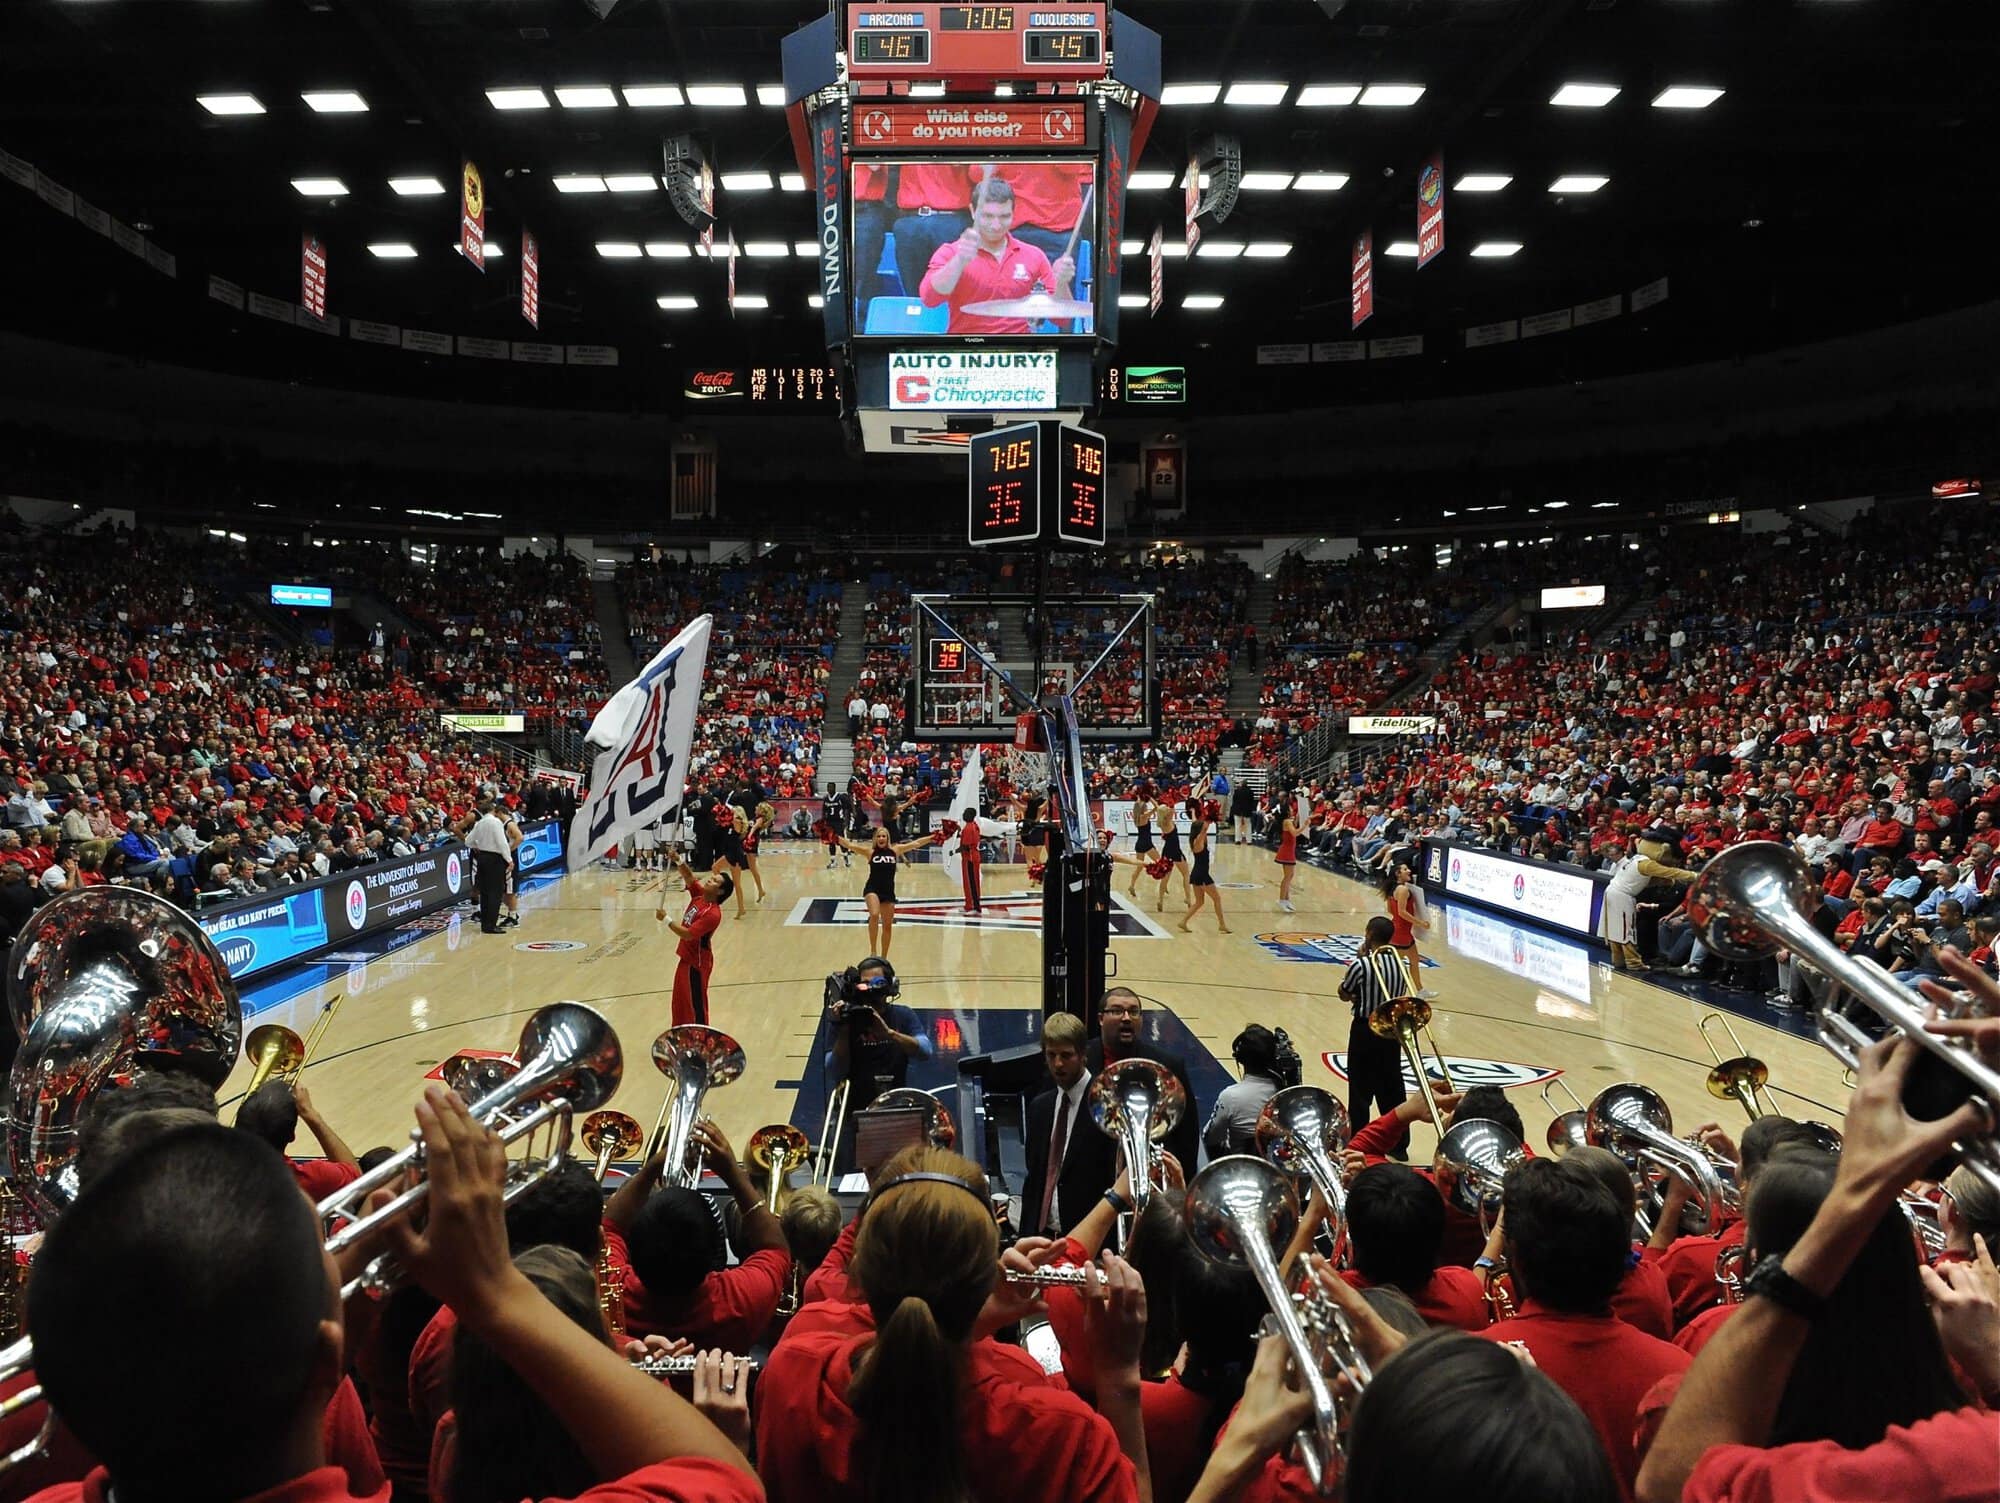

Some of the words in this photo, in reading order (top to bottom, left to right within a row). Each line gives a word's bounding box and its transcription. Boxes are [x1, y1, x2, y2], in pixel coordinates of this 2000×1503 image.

[869, 14, 914, 26] ARIZONA
[960, 8, 1013, 29] 7:05
[1034, 13, 1090, 26] DUQUESNE
[880, 36, 911, 57] 46
[1052, 36, 1082, 57] 45
[926, 109, 969, 123] What
[976, 110, 1008, 123] else
[912, 123, 934, 138] do
[938, 125, 967, 140] you
[971, 123, 1023, 138] need?
[1422, 231, 1439, 257] 2001
[893, 354, 953, 368] AUTO
[959, 354, 1054, 368] INJURY?
[693, 371, 735, 386] Coca-Cola
[934, 387, 1046, 404] Chiropractic
[990, 440, 1032, 472] 7:05
[1073, 443, 1101, 475] 7:05
[985, 481, 1021, 526] 35
[1070, 481, 1096, 526] 35
[941, 643, 962, 652] 7:05
[938, 654, 958, 667] 35
[458, 718, 503, 726] SUNSTREET
[1371, 718, 1420, 728] Fidelity
[366, 875, 378, 889] THE
[378, 867, 407, 885] UNIVERSITY
[407, 865, 414, 876] OF
[414, 860, 436, 874] ARIZONA
[389, 879, 419, 897] PHYSICIANS
[238, 917, 250, 926] OLD
[249, 909, 268, 923] NAVY
[227, 943, 251, 966] NAVY
